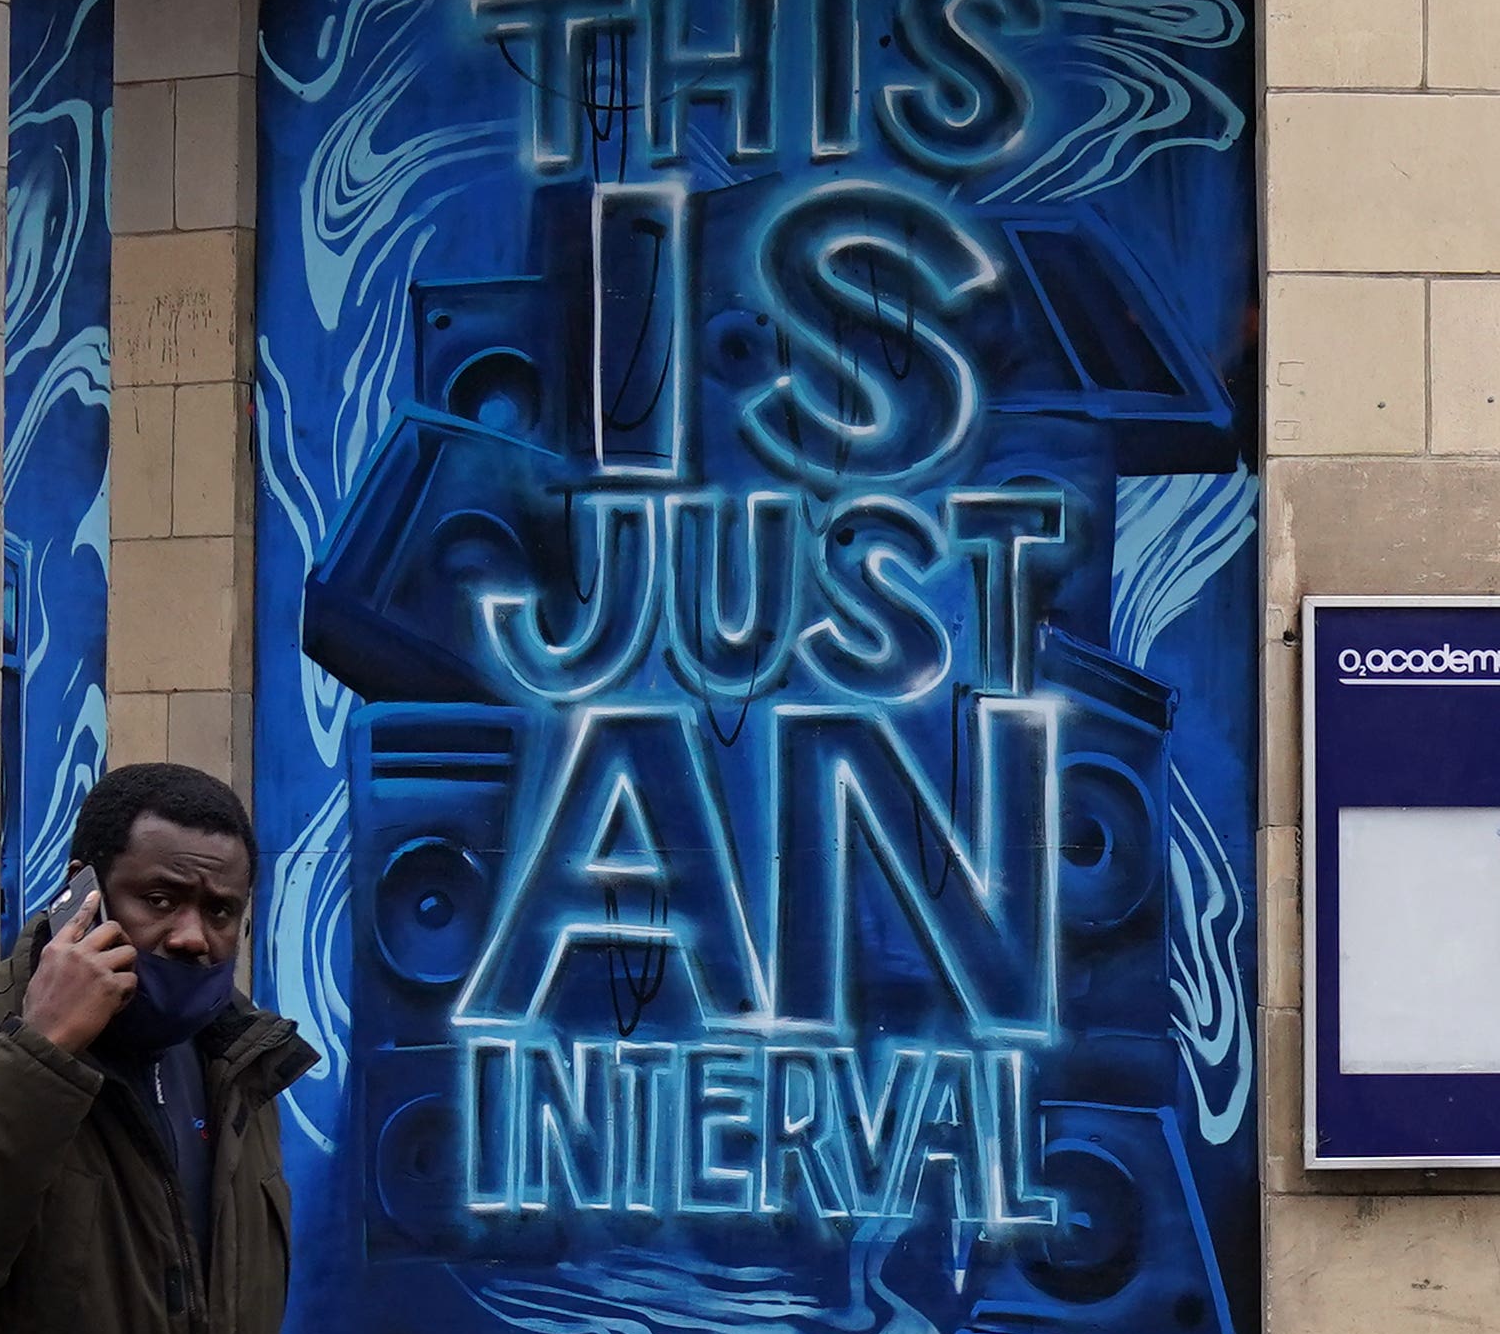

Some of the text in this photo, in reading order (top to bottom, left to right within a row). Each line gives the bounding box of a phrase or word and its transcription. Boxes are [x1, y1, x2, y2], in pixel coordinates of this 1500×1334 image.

[592, 179, 1002, 487] IS
[480, 489, 1068, 703] JUST
[450, 697, 1060, 1042] AN
[465, 1035, 1062, 1227] INTERVAL
